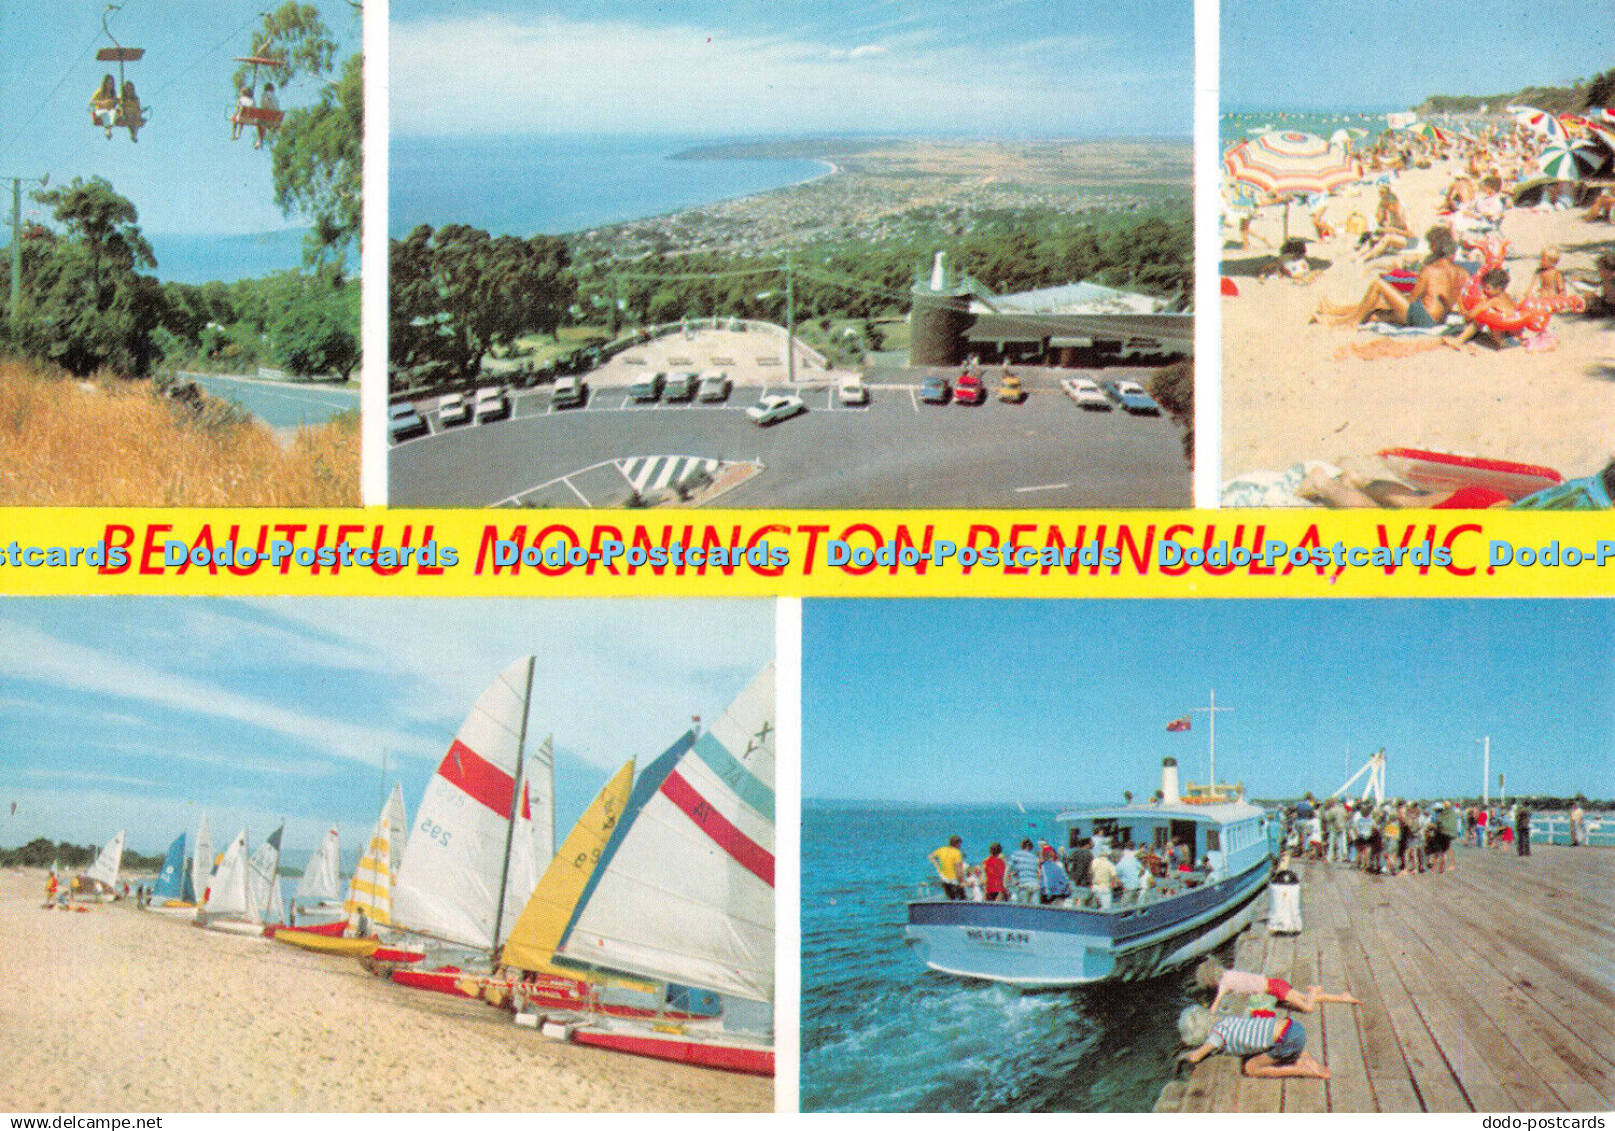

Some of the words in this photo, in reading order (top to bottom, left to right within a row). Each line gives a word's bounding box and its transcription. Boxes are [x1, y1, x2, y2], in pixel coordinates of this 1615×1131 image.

[97, 523, 445, 576] BEAUTIFUL
[474, 523, 935, 577] MORNINGTON
[1376, 523, 1496, 577] VIC.
